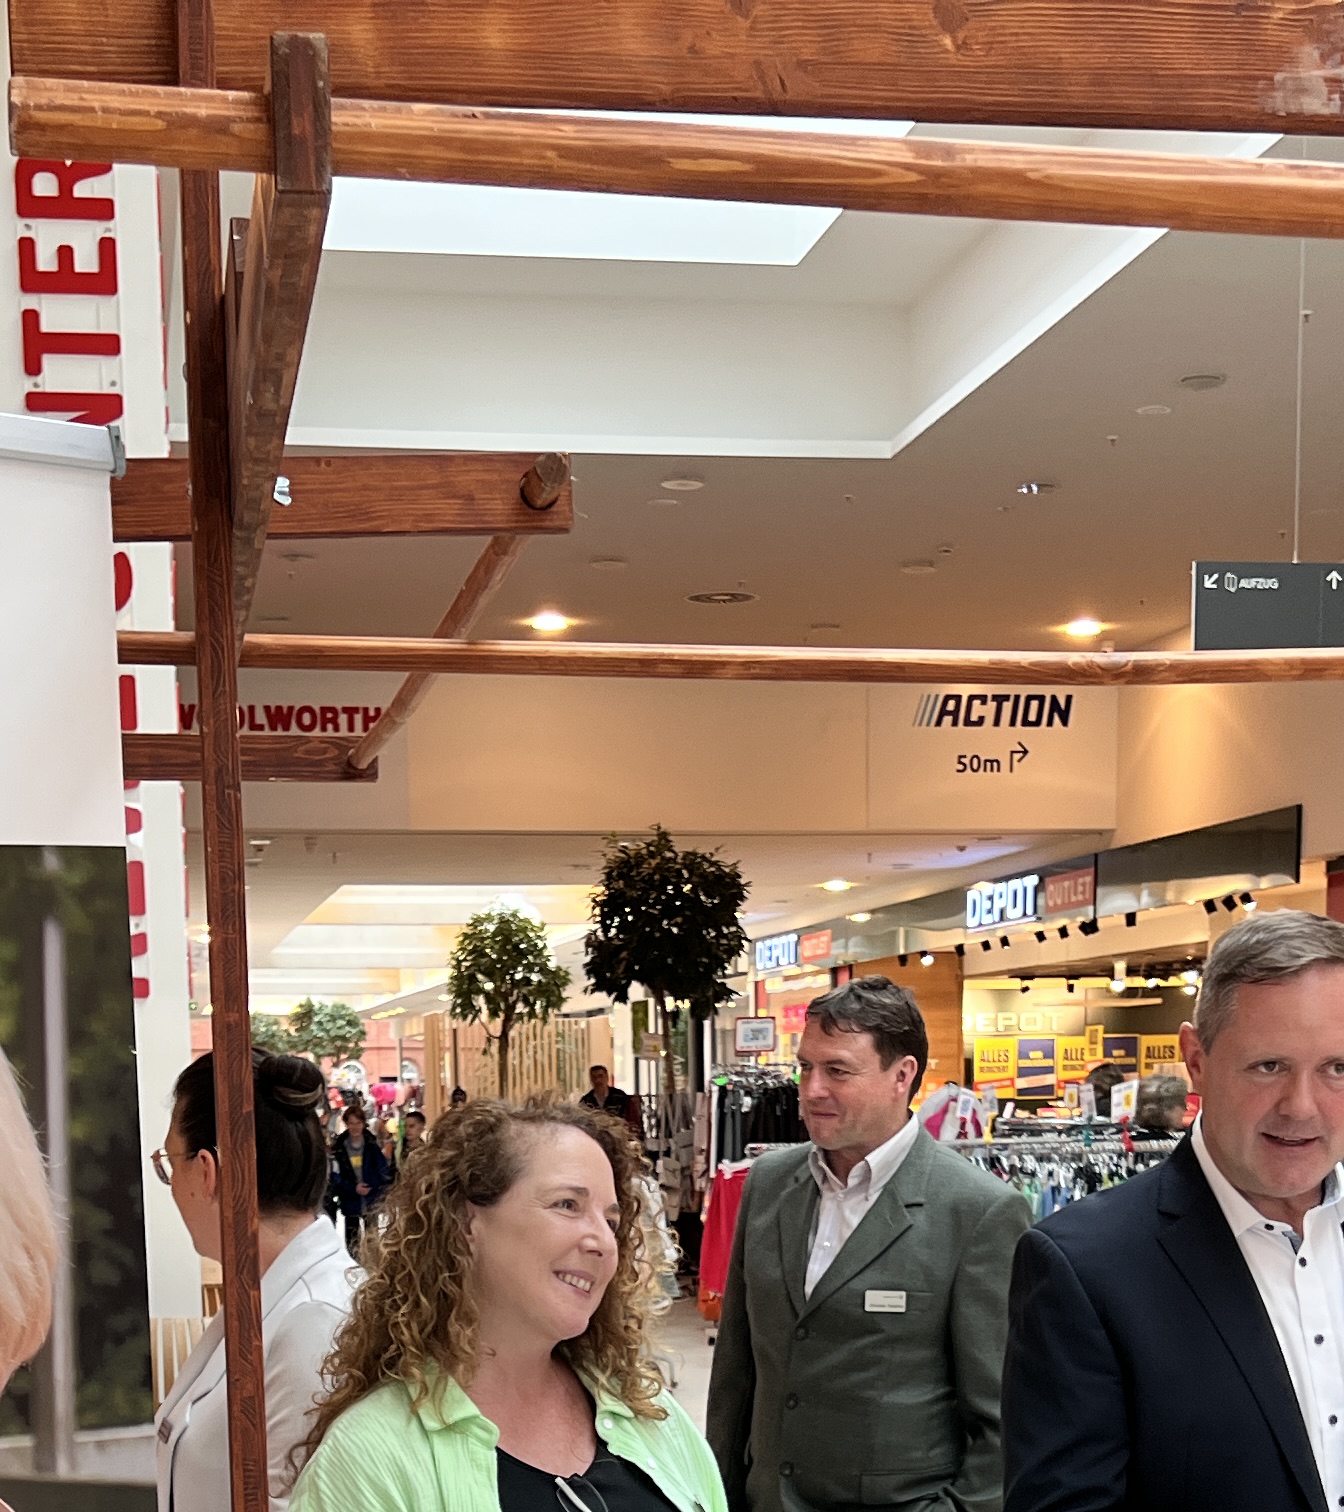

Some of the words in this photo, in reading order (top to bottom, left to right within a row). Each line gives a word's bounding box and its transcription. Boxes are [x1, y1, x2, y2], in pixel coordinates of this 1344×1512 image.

[1239, 578, 1279, 589] AUFZUG
[179, 703, 383, 734] WLWORTH
[934, 694, 1074, 728] ACTION
[955, 754, 1001, 773] 50m
[966, 874, 1039, 928] DEPOT
[1047, 876, 1092, 907] OUTLET
[756, 933, 798, 970] DEPOT
[980, 1048, 1010, 1063] ALLES
[1063, 1047, 1086, 1061] ALLE
[1145, 1045, 1176, 1060] ALLES
